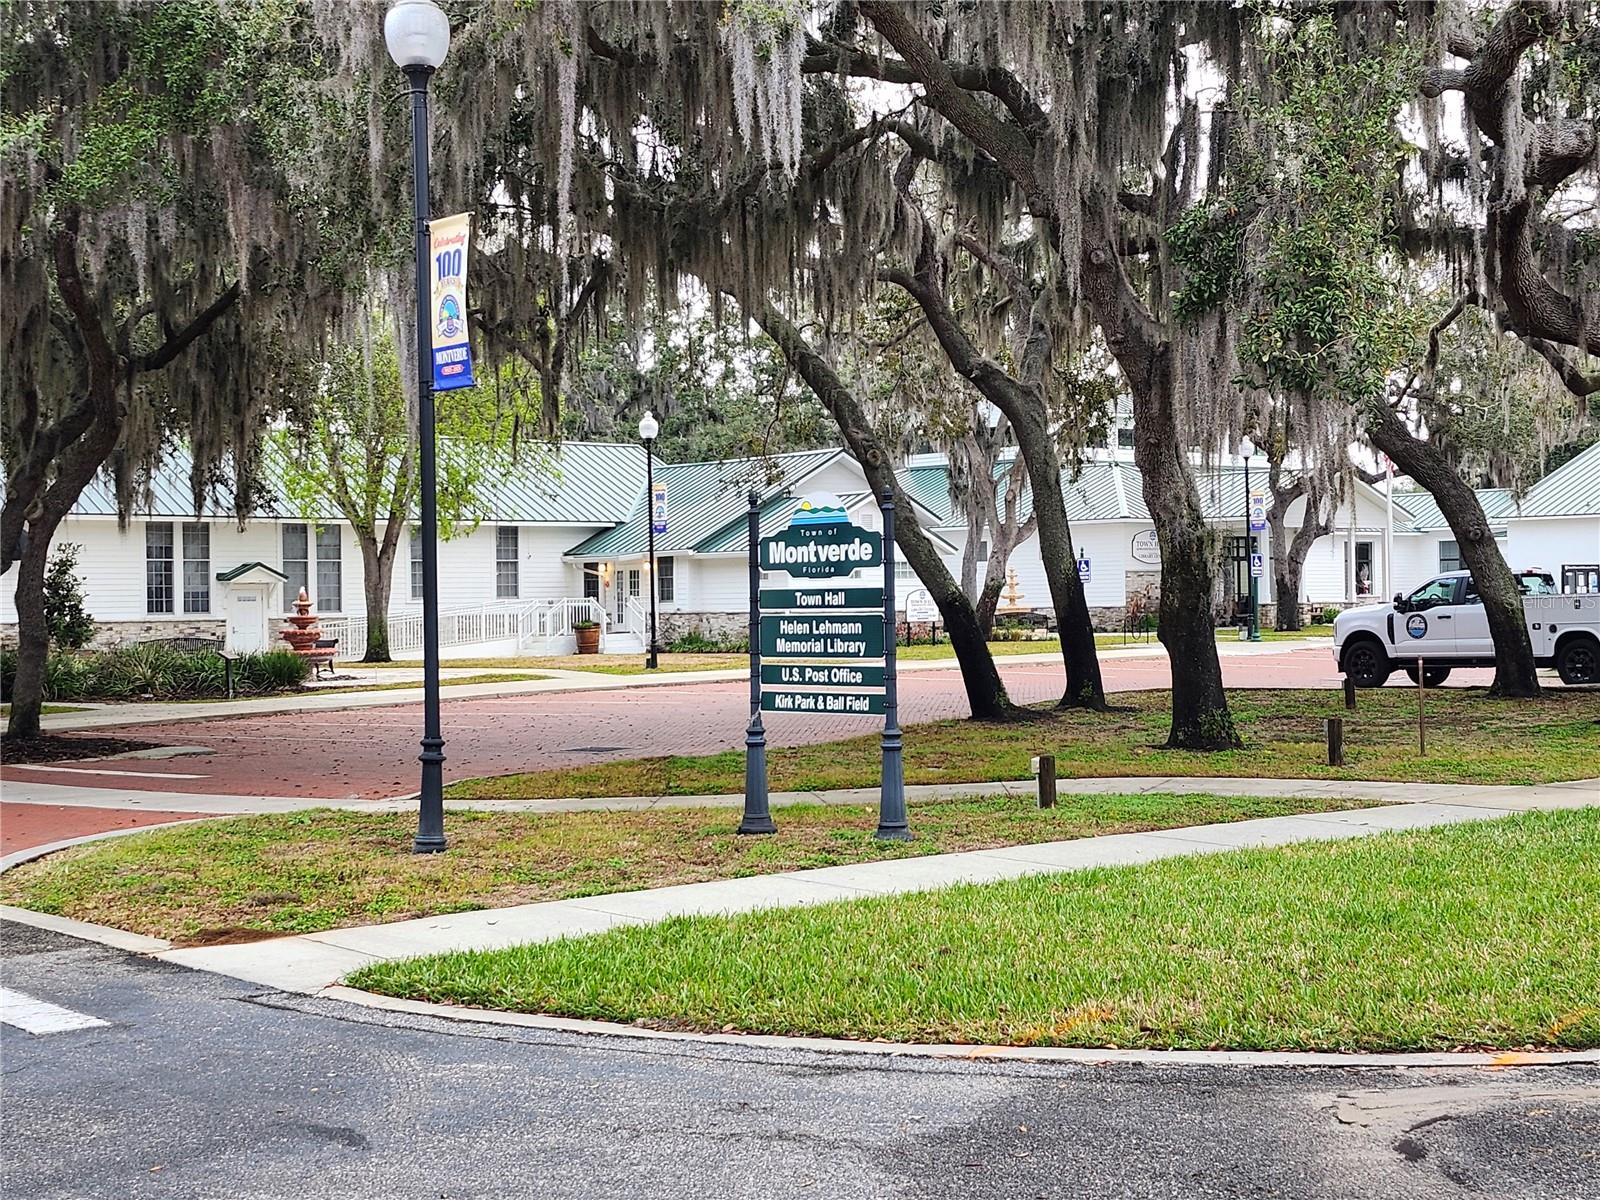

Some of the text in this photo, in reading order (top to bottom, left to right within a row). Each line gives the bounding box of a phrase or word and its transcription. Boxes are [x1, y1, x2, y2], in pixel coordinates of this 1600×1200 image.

[436, 248, 462, 281] 100
[801, 528, 838, 537] Town of
[769, 538, 873, 564] Montverde
[802, 565, 835, 574] Florida
[795, 591, 845, 607] Town Hall
[779, 620, 862, 635] Helen Lehmann
[776, 638, 866, 656] Memorial Library
[781, 667, 863, 684] U.S. Post Office
[775, 694, 870, 712] Kirk Park & Ball Field
